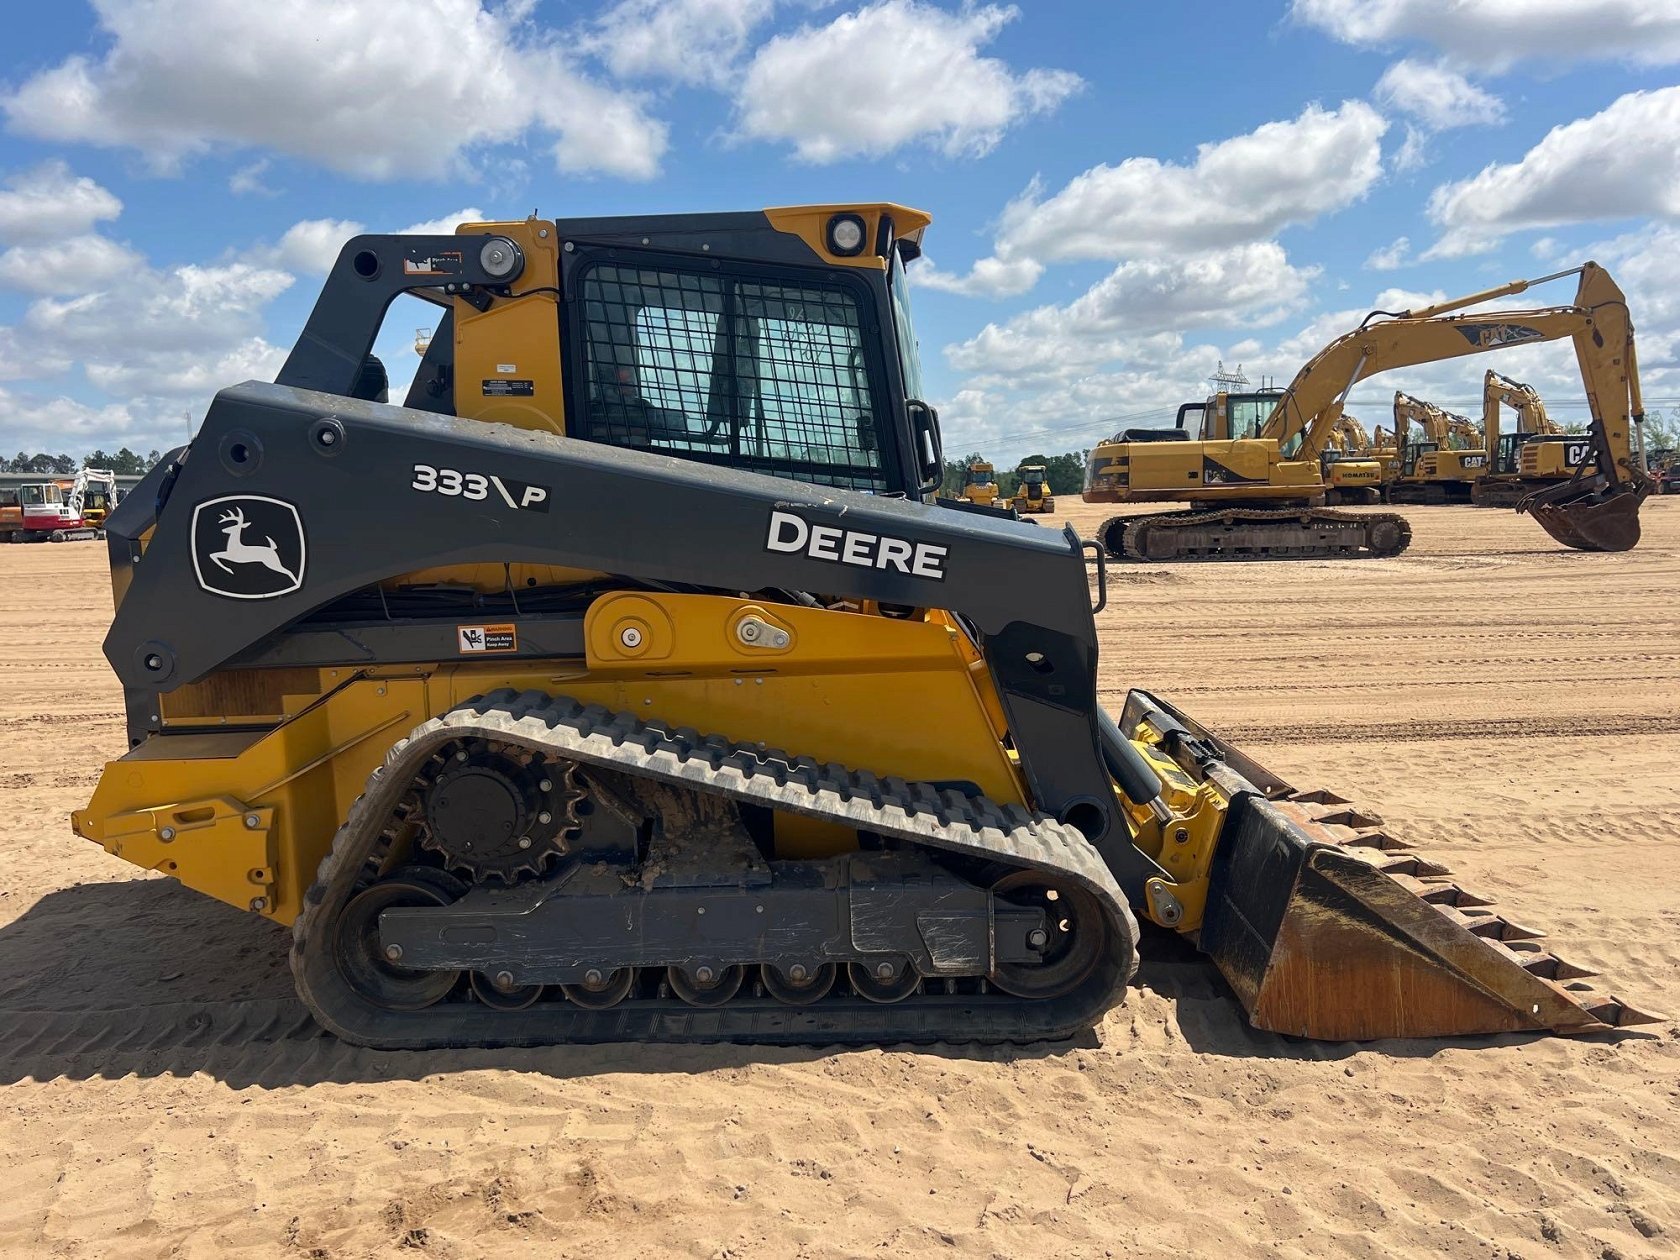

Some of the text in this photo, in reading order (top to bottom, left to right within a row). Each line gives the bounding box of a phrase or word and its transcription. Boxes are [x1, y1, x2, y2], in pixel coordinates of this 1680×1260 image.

[1464, 456, 1482, 468] CAT
[1342, 471, 1376, 479] KOMATSU
[766, 510, 948, 579] DEERE
